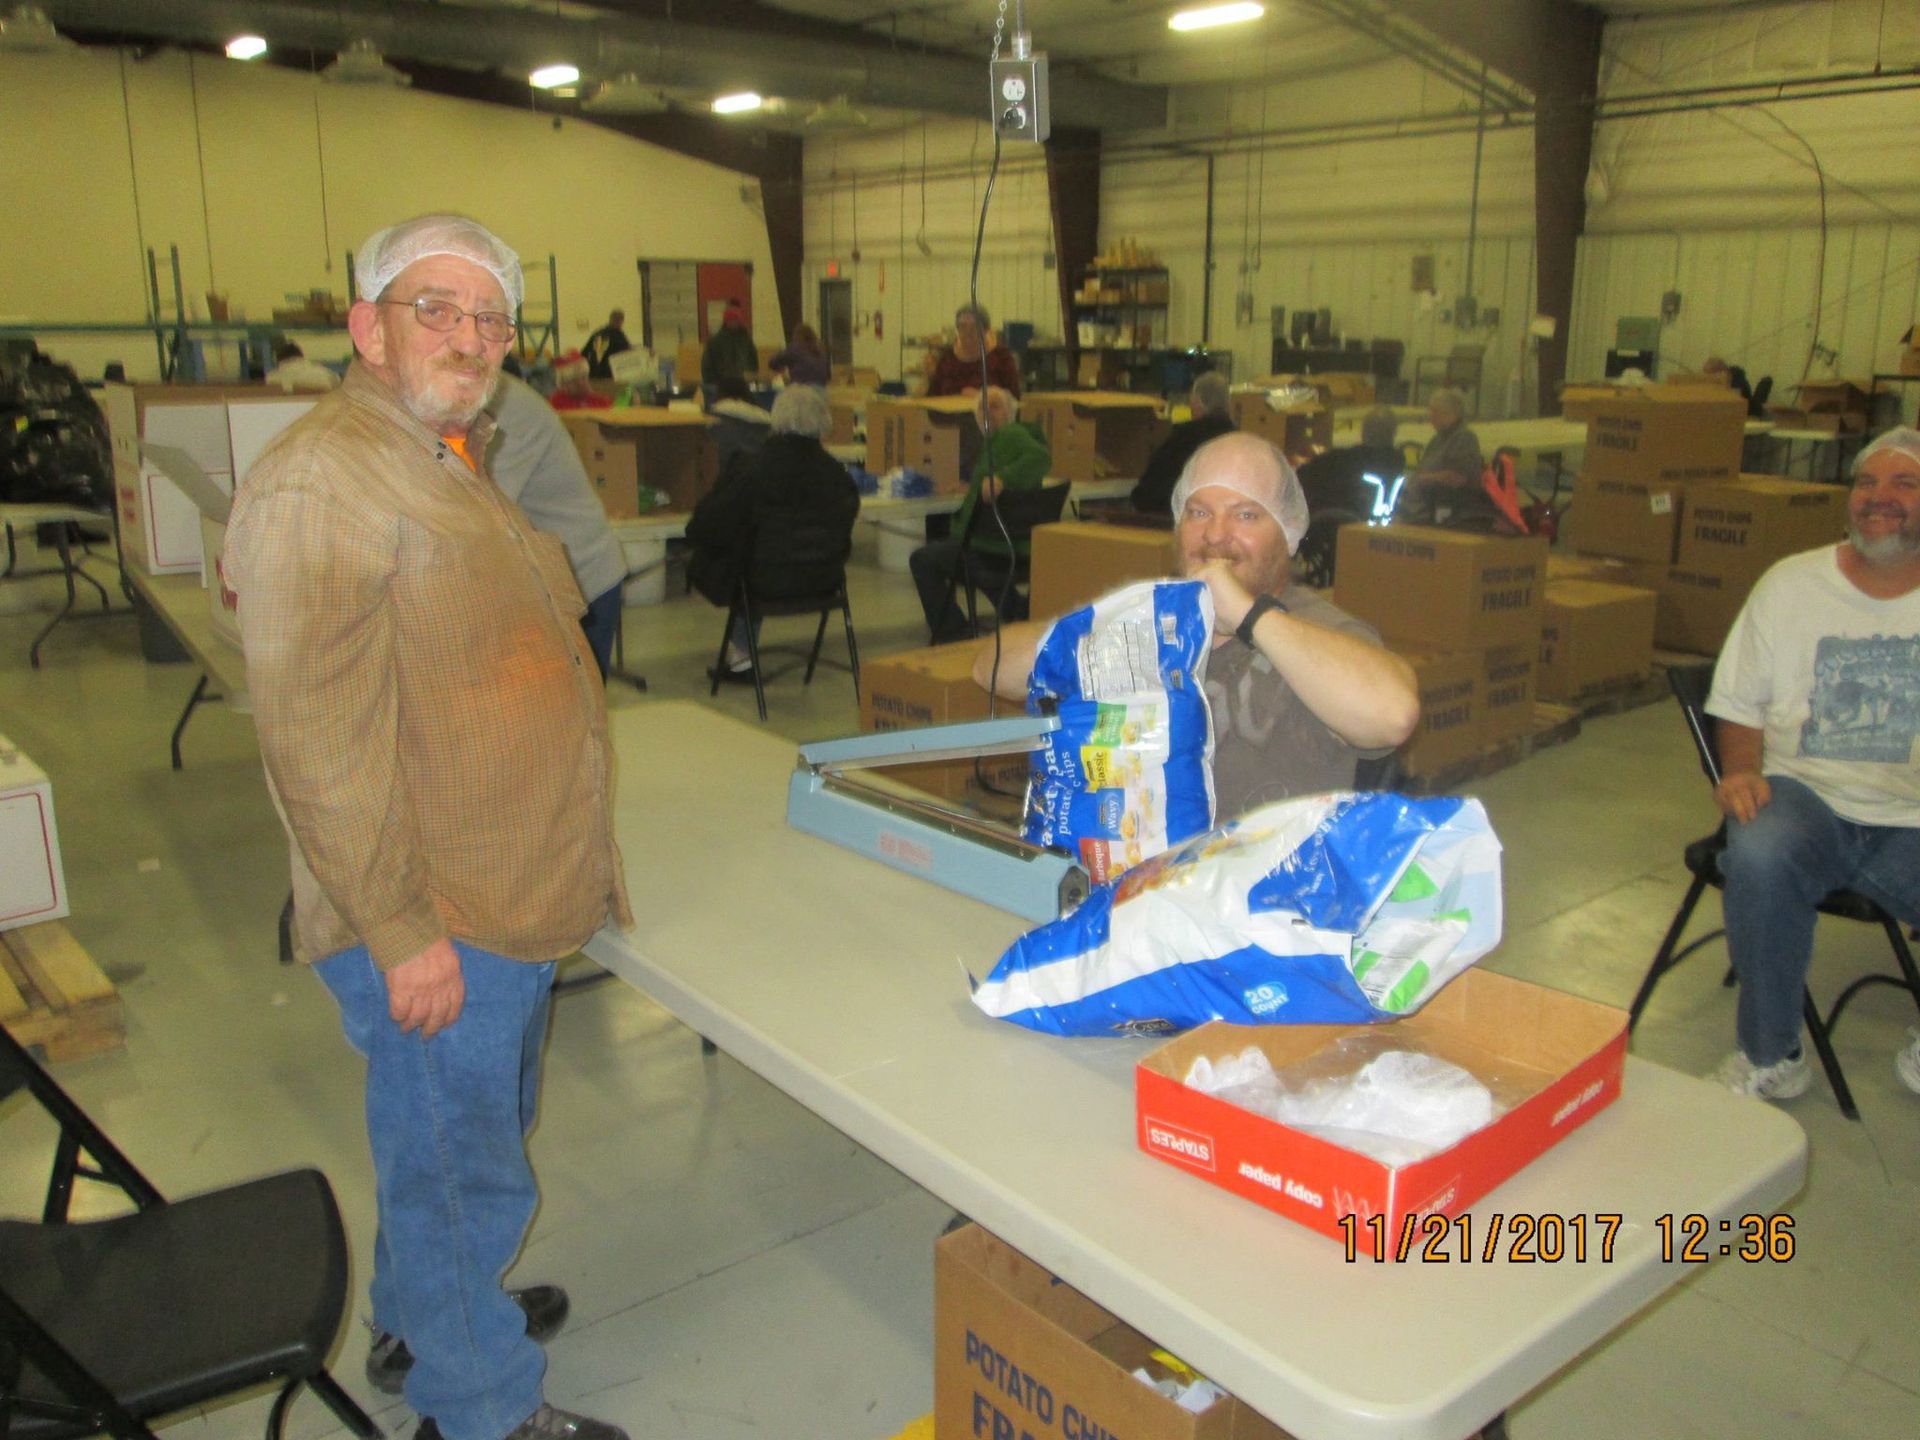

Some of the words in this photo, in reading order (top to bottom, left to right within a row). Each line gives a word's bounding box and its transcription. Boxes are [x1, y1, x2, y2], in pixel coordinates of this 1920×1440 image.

[1695, 526, 1747, 545] FRAGILE
[1482, 588, 1531, 612] FRAGILE
[1042, 732, 1064, 776] pac
[1108, 800, 1119, 830] Wavy
[1244, 987, 1273, 1004] 20
[1252, 994, 1290, 1014] COUNT
[1150, 1128, 1210, 1161] STAPLES
[1238, 1162, 1282, 1197] paper
[1285, 1179, 1324, 1209] copy
[965, 1328, 1054, 1424] POTATO
